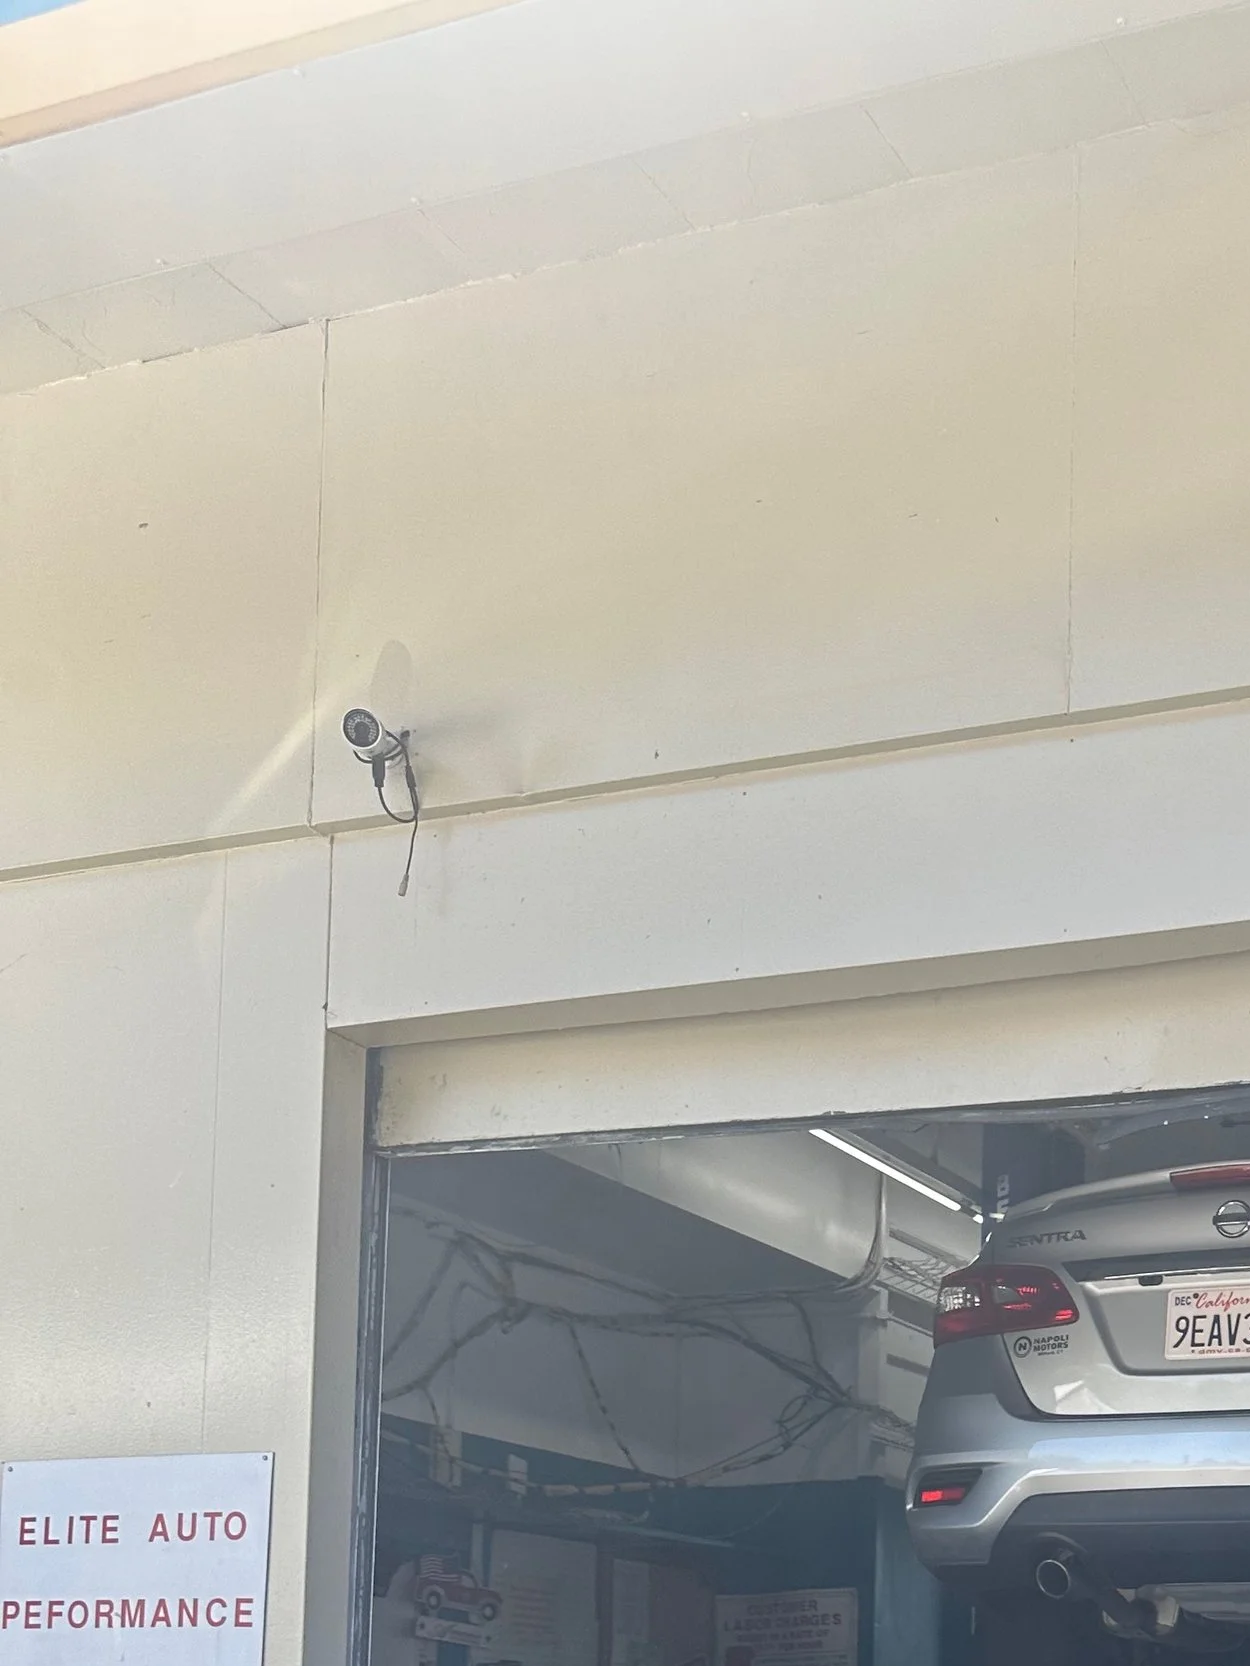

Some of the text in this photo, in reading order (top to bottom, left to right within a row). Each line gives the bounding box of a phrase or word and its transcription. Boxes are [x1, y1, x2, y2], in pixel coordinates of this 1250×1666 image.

[1006, 1229, 1087, 1248] SENTRA
[1175, 1296, 1191, 1306] DEC
[1033, 1334, 1069, 1344] NAPOLI
[1033, 1341, 1069, 1352] MOTORS
[19, 1511, 247, 1546] ELITE AUTO
[1, 1597, 254, 1630] PEFORMANCE
